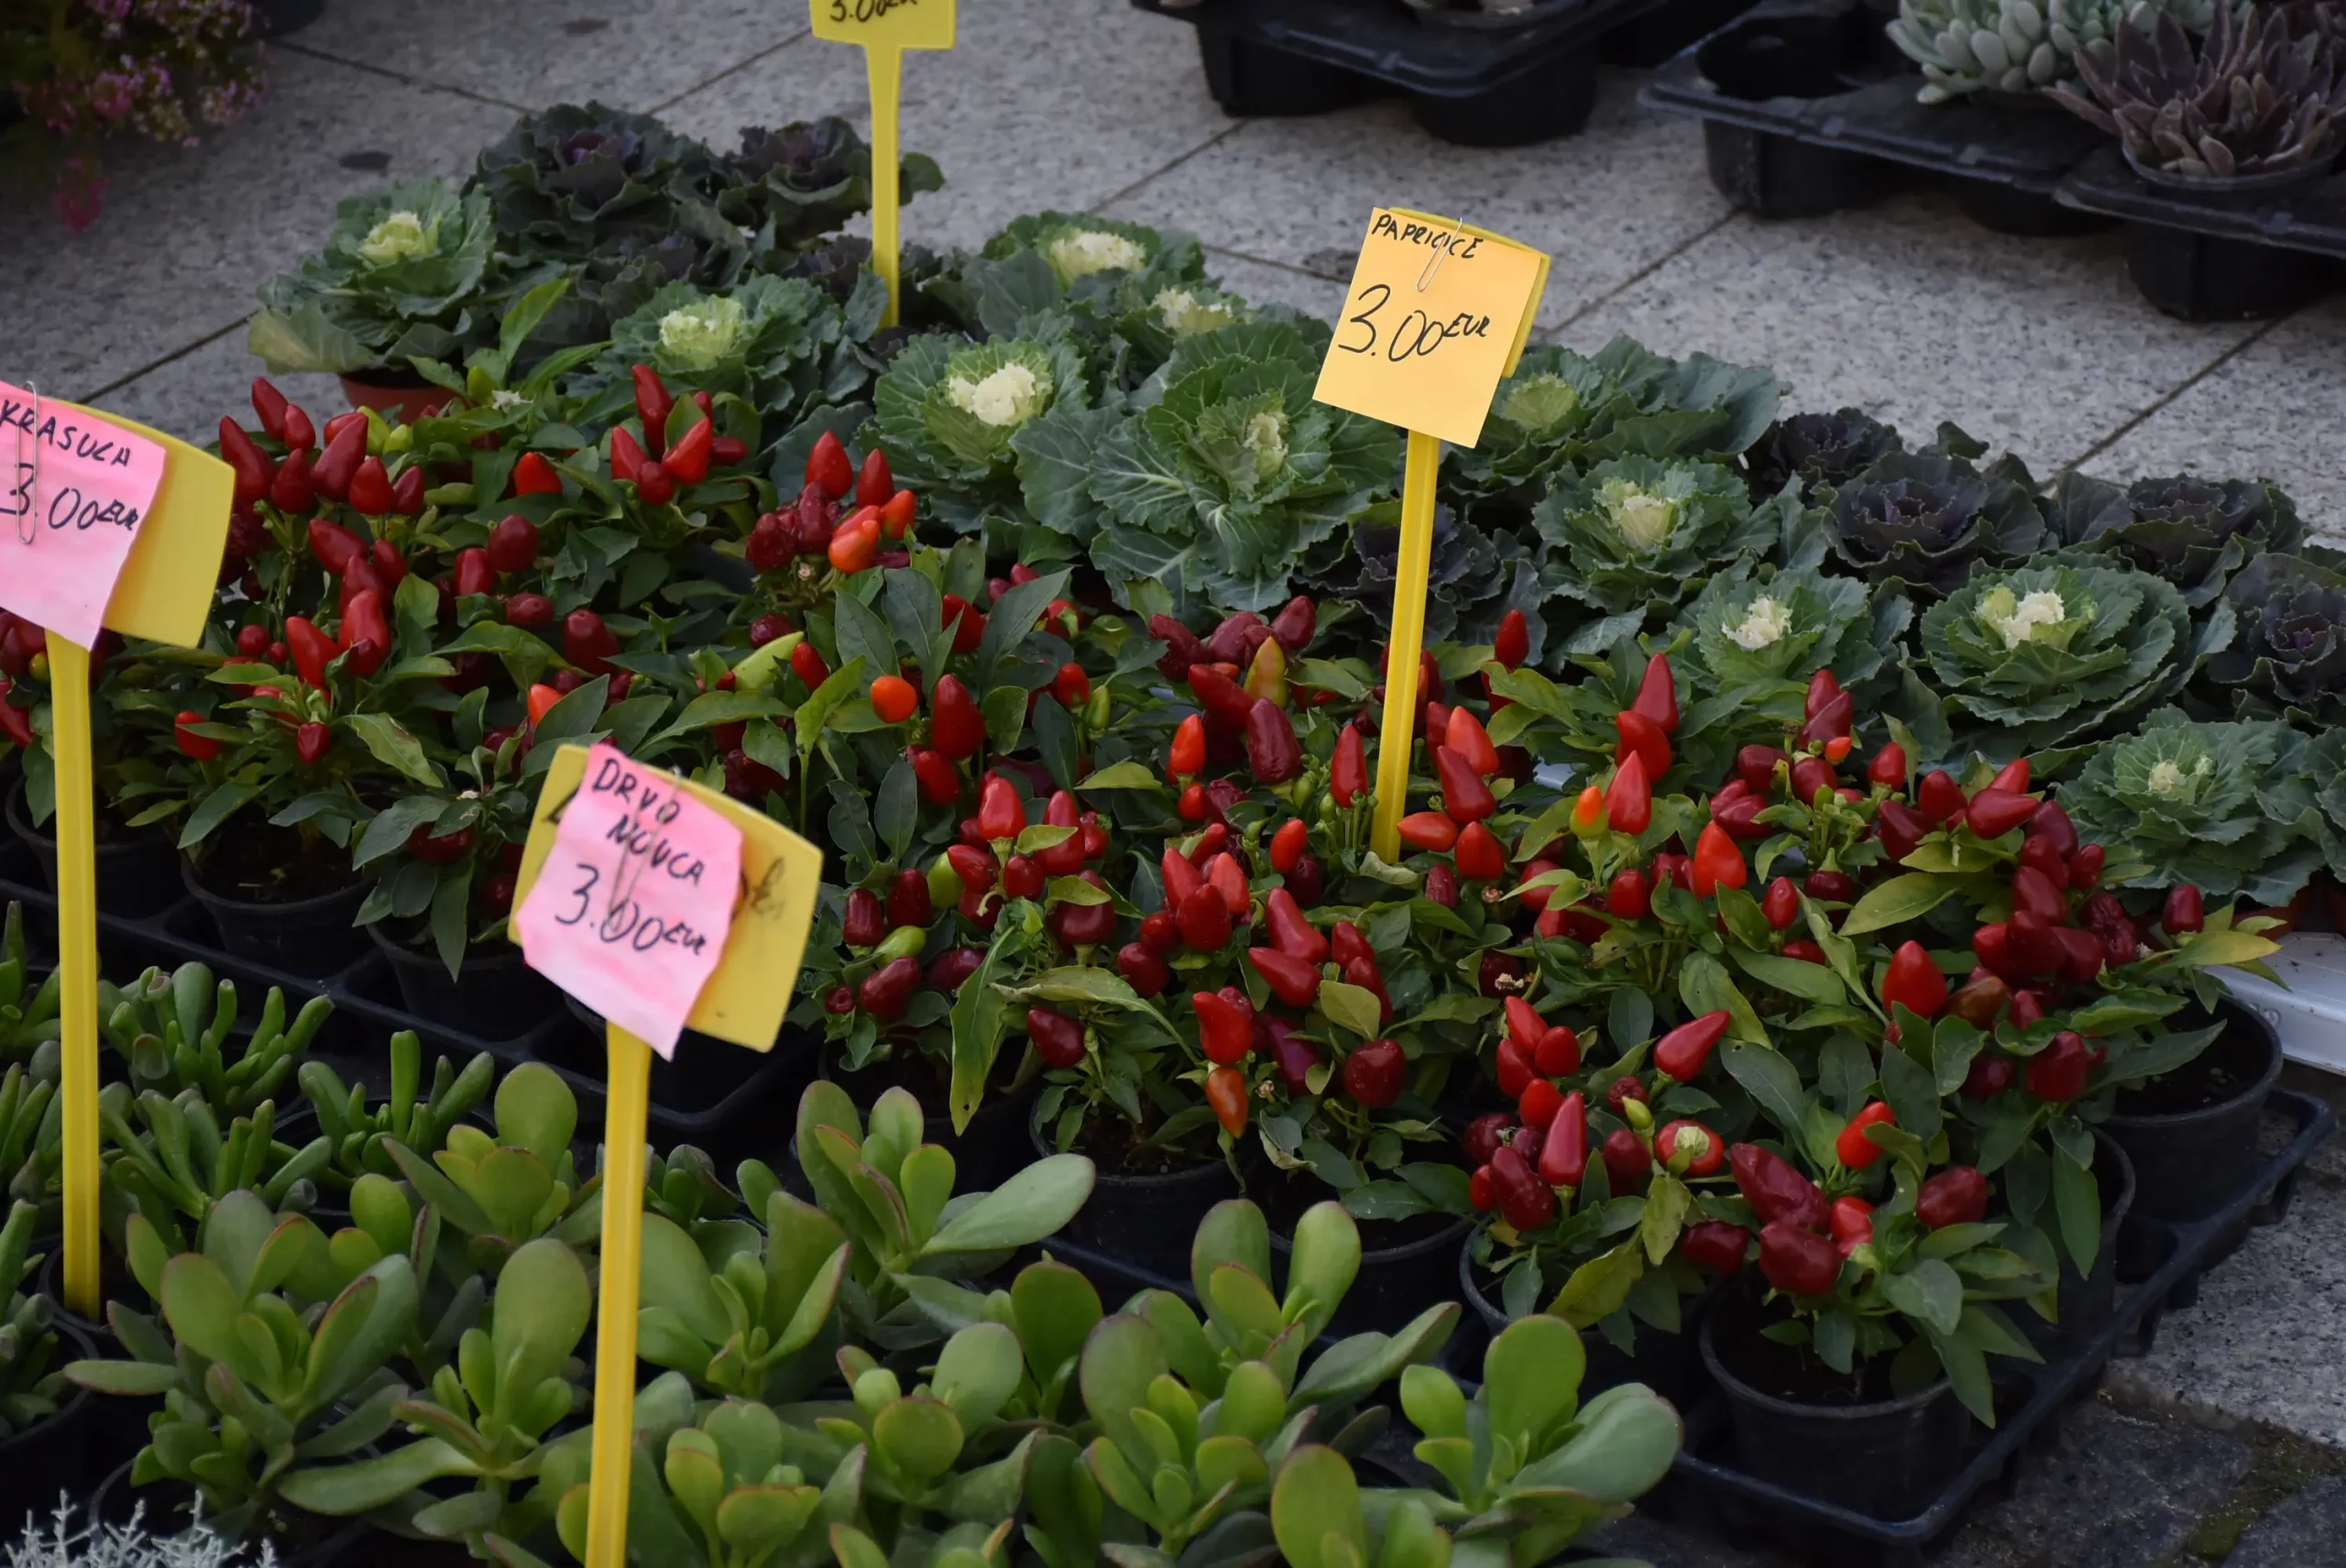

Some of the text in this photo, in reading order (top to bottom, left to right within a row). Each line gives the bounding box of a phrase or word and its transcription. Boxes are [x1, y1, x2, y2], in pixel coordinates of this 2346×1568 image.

[1338, 284, 1490, 362] 3.00EUR
[592, 758, 681, 825] DRVO
[554, 863, 707, 956] 3.00EUR
